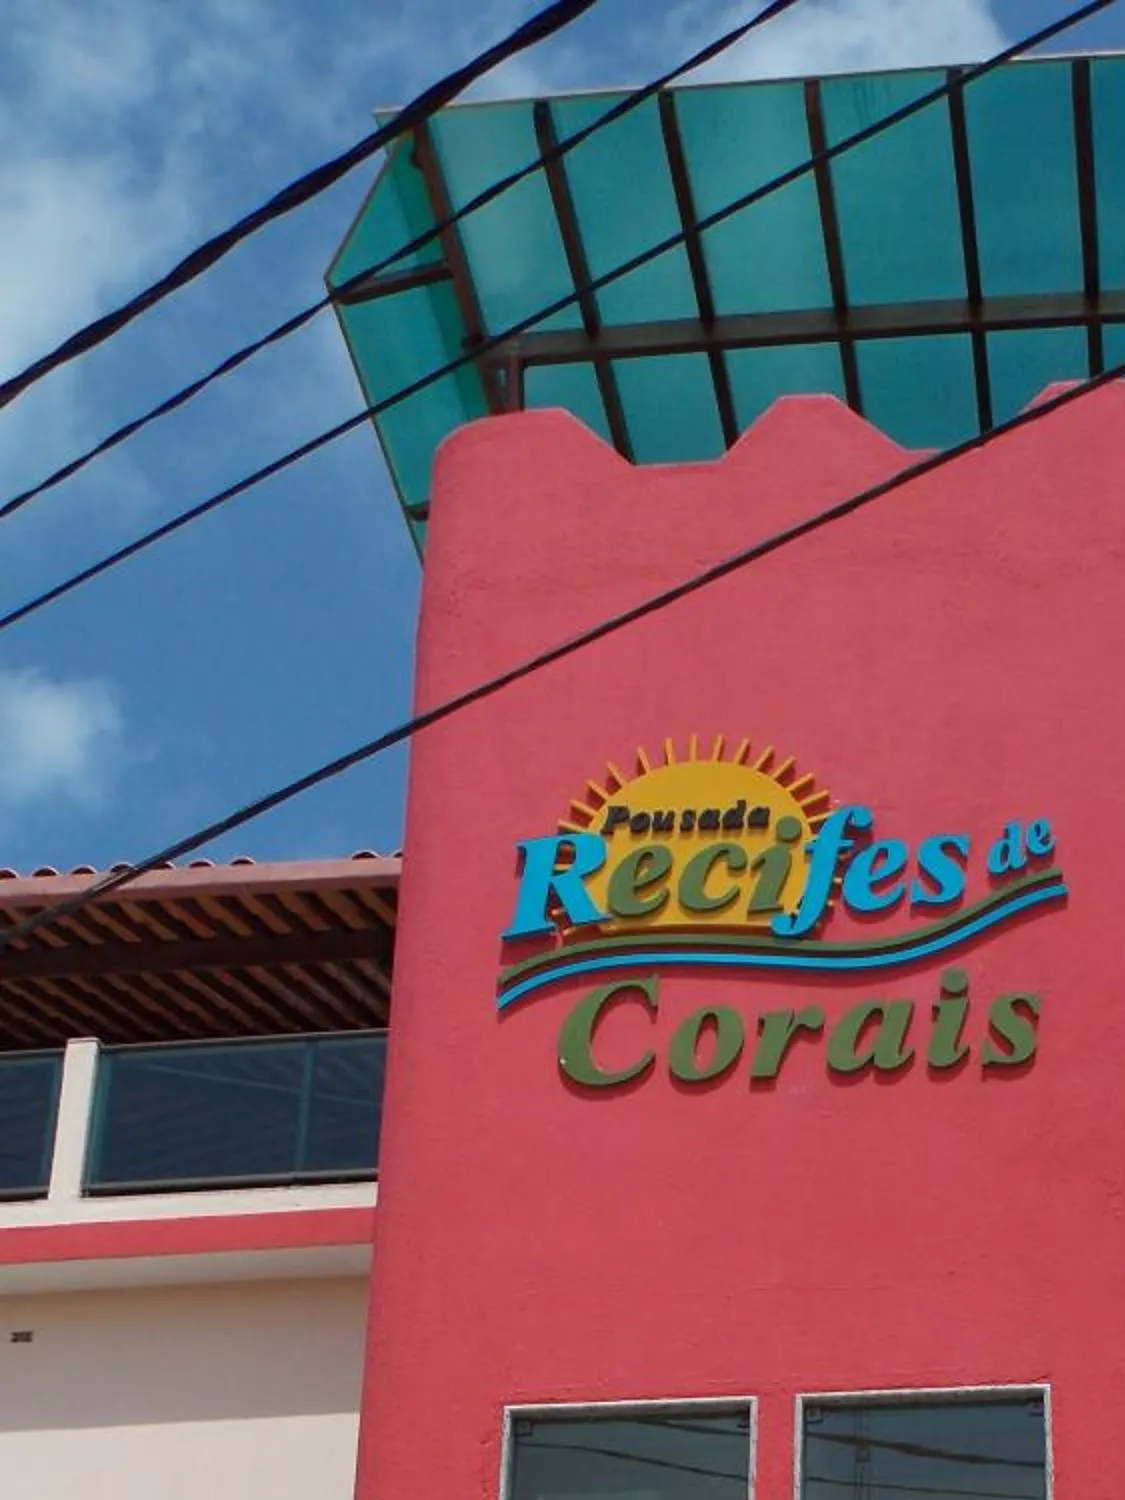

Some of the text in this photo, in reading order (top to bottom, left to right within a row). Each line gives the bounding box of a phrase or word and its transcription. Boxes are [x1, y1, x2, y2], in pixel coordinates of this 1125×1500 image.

[500, 804, 1056, 942] Recifes de
[601, 800, 770, 836] Pousada
[557, 968, 1041, 1087] Corais
